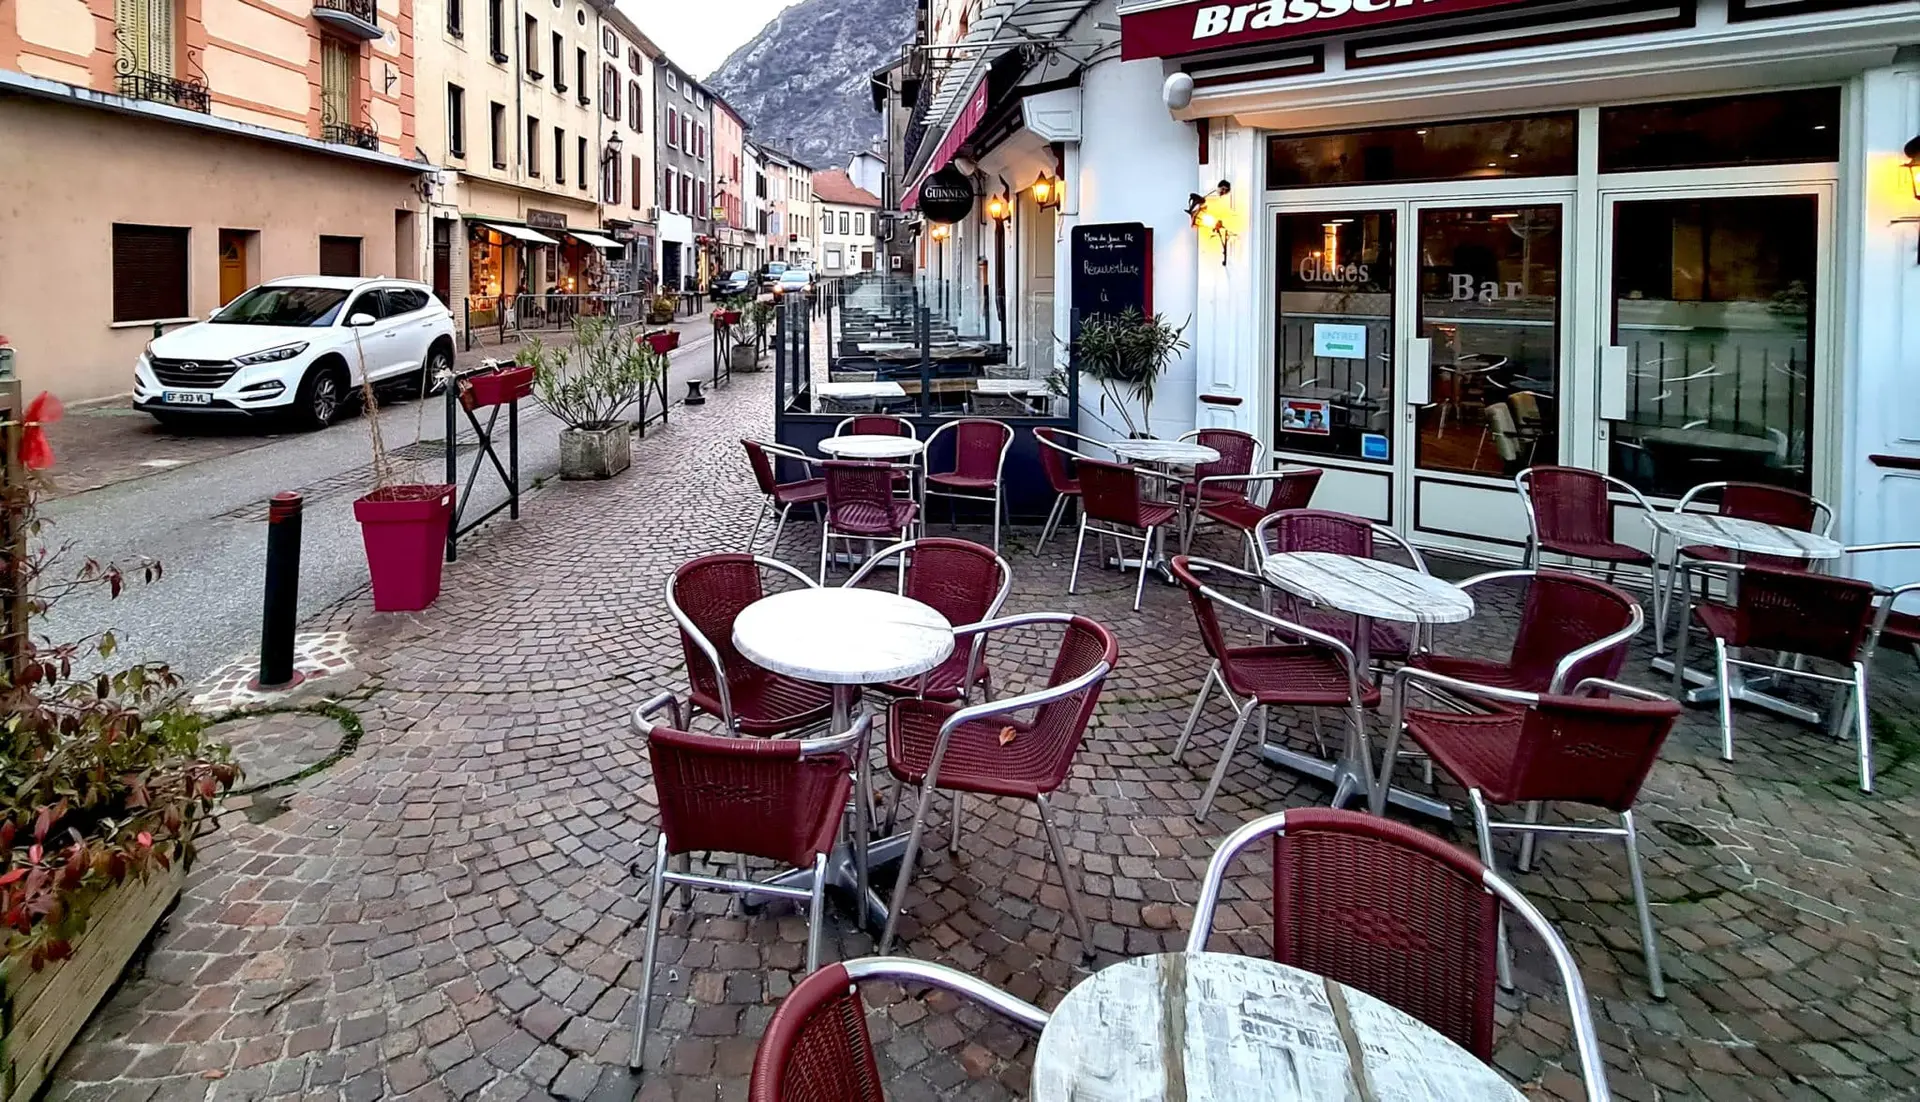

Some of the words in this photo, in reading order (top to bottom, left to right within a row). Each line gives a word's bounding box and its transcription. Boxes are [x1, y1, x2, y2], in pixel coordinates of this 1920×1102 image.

[1192, 0, 1436, 40] Brass
[925, 187, 970, 199] GUINNESS
[1299, 256, 1369, 283] Glaces
[1448, 272, 1524, 302] Bar
